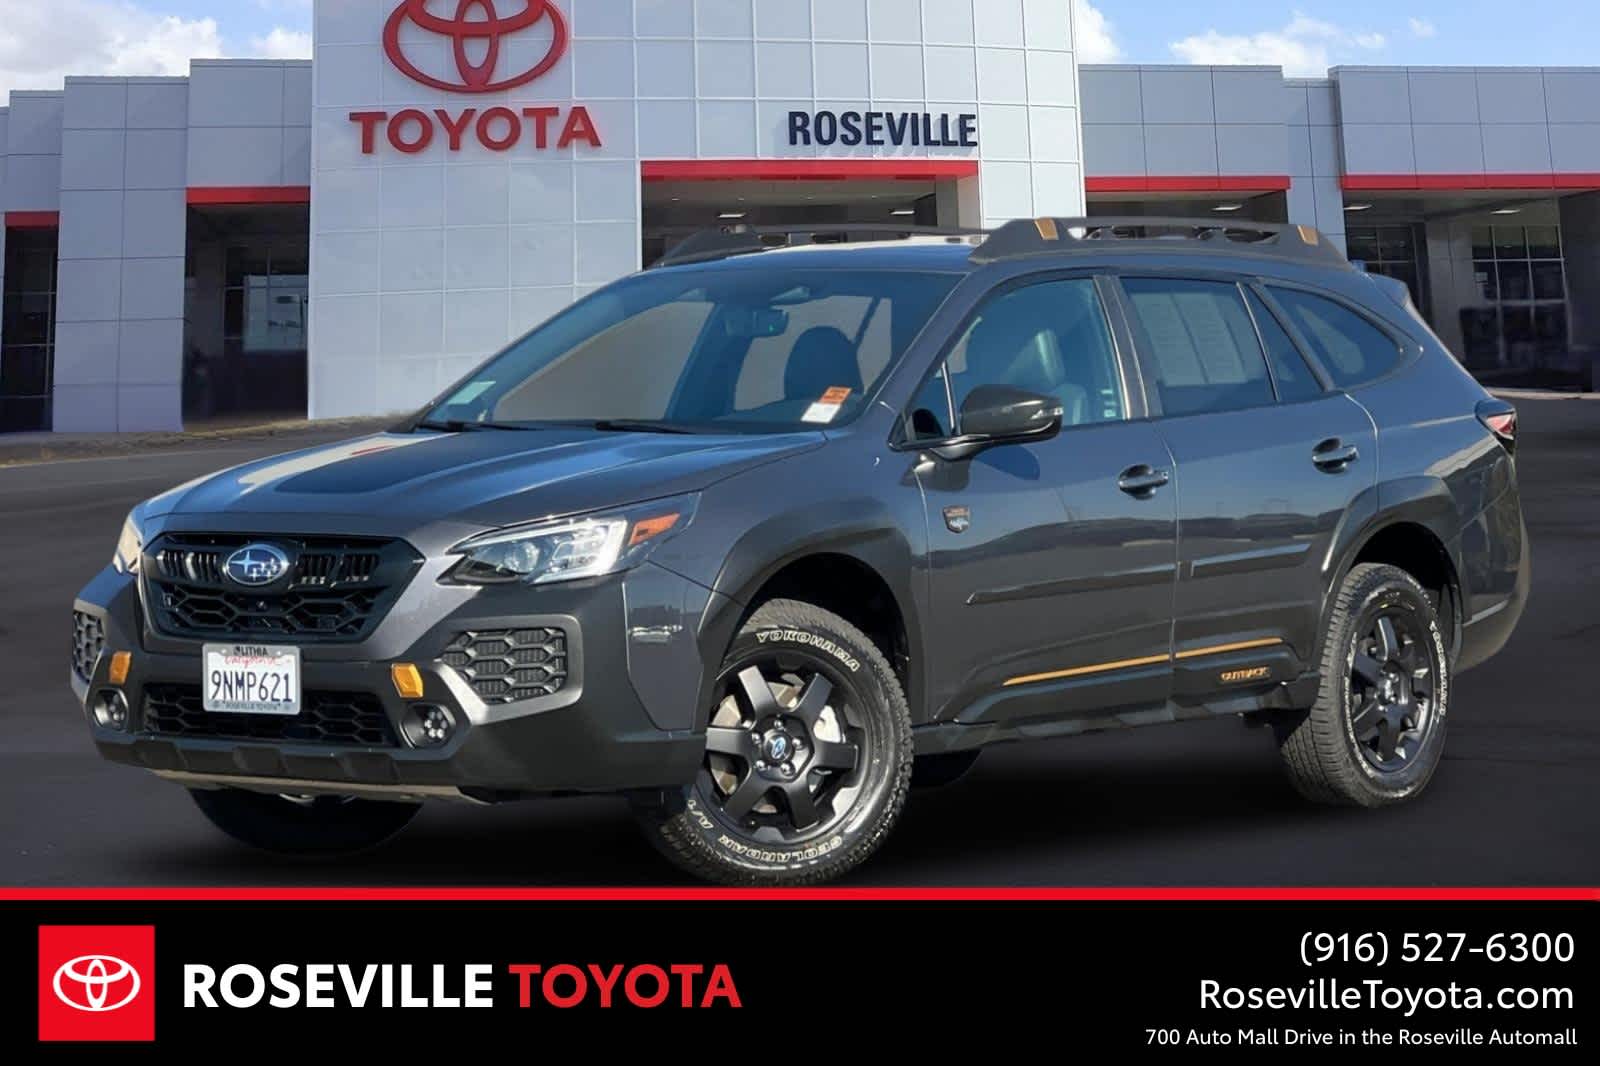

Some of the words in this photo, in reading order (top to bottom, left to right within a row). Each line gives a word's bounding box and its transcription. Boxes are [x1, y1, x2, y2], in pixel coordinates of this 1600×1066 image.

[349, 106, 602, 154] TOYOTA
[788, 111, 978, 147] ROSEVILLE
[241, 646, 269, 657] LITHIA
[757, 629, 860, 672] YOKOHAMA
[211, 669, 292, 703] 9NMP621
[718, 834, 842, 862] GEOLANDAR
